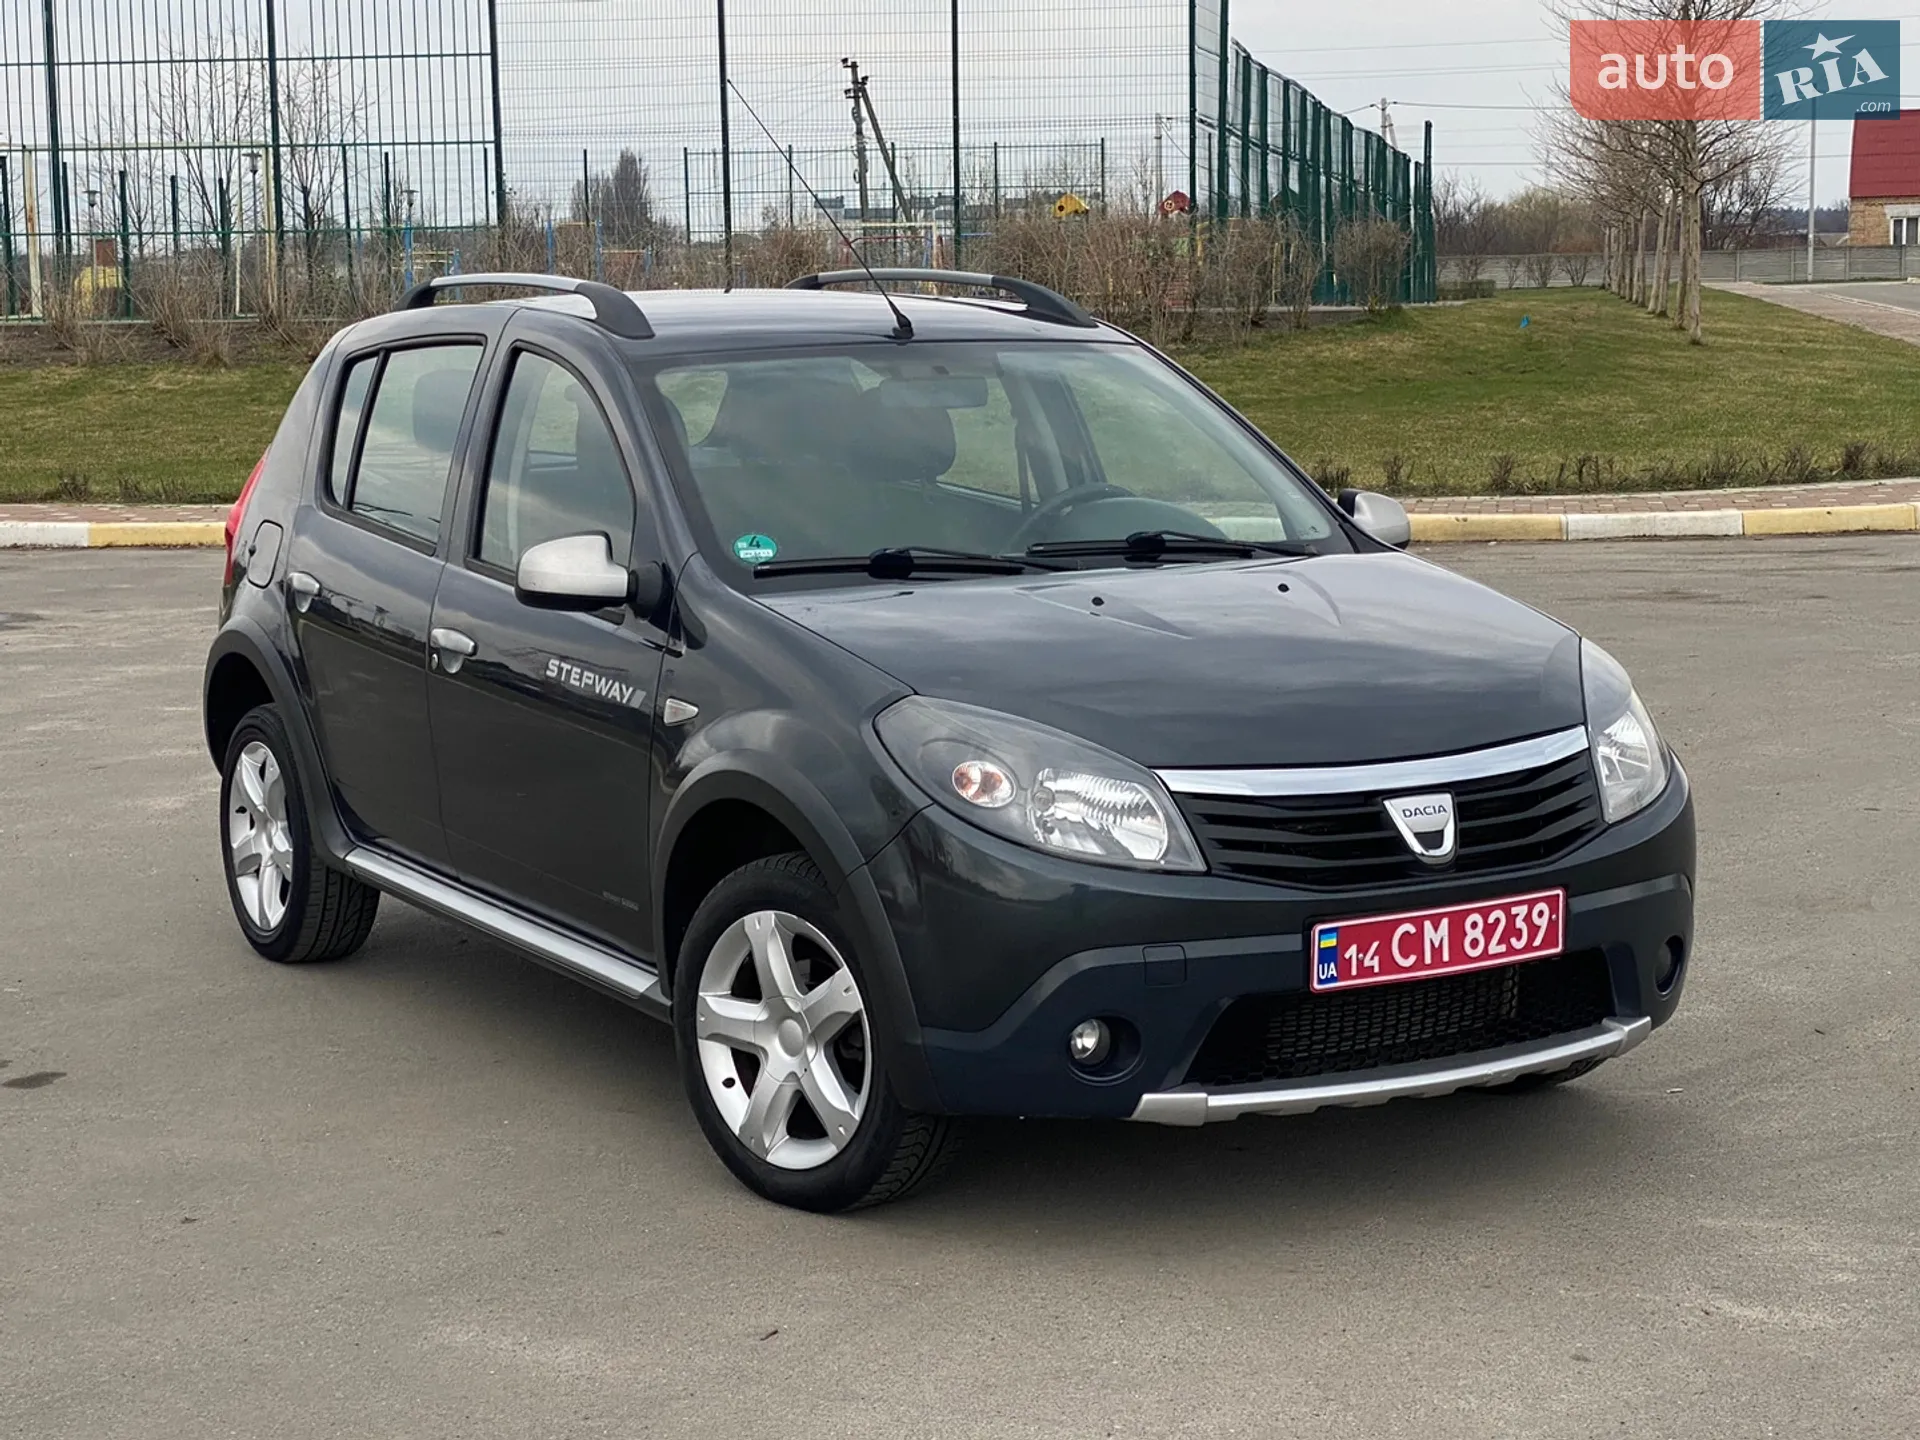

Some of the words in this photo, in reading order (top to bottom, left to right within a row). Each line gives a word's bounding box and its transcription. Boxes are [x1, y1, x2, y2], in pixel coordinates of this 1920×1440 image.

[748, 535, 761, 549] 4
[545, 658, 634, 705] STEPWAY
[1401, 803, 1448, 819] DACIA
[1343, 940, 1381, 977] 14
[1391, 916, 1450, 968] CM
[1463, 901, 1550, 959] 8239
[1318, 963, 1338, 980] UA
